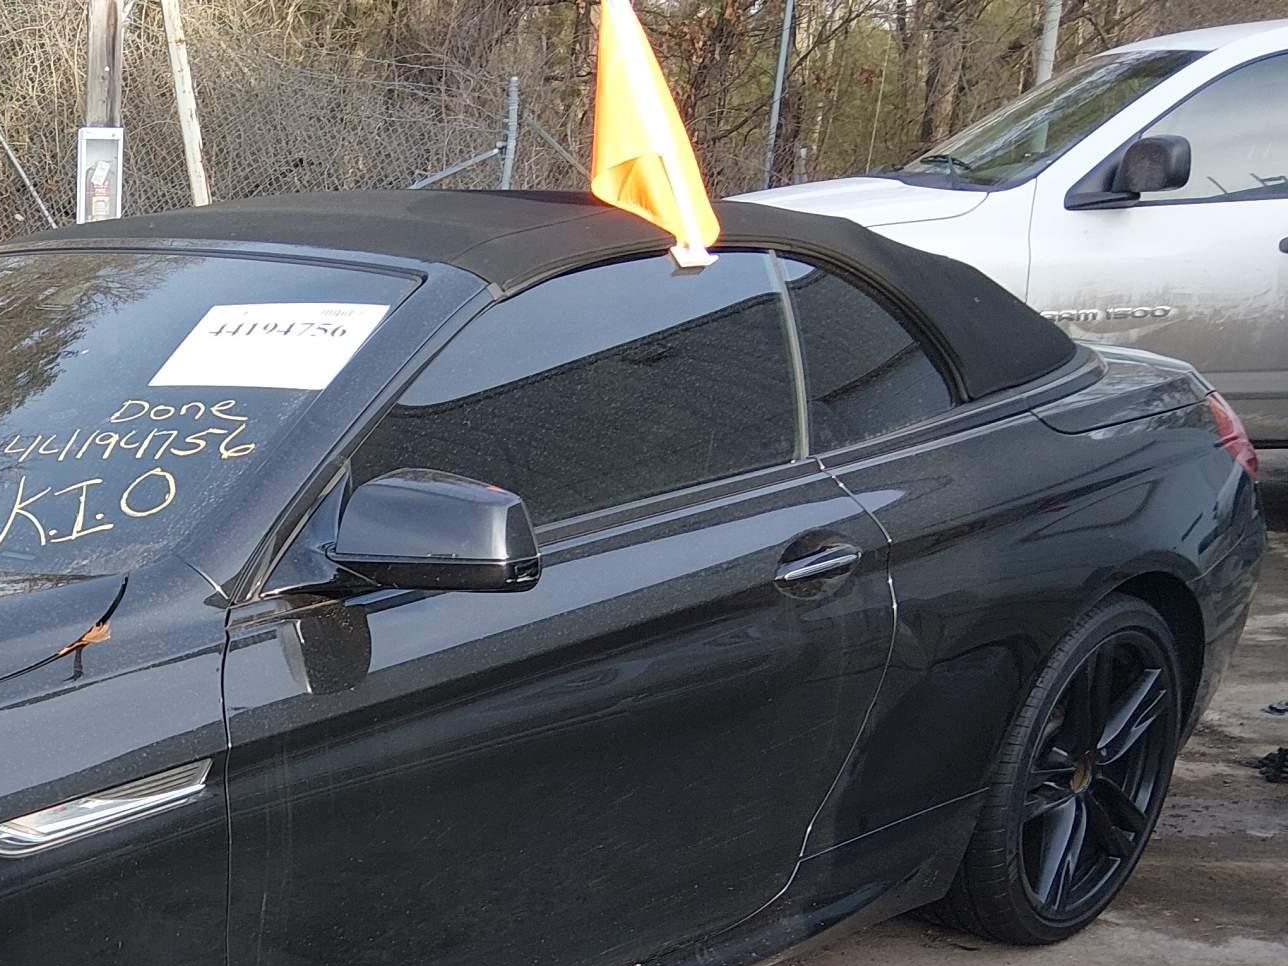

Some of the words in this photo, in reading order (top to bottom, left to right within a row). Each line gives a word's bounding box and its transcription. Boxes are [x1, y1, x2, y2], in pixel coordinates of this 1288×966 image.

[1105, 305, 1172, 321] 1500
[208, 322, 348, 337] 44194756
[110, 399, 249, 423] Done
[3, 423, 257, 463] 44194756
